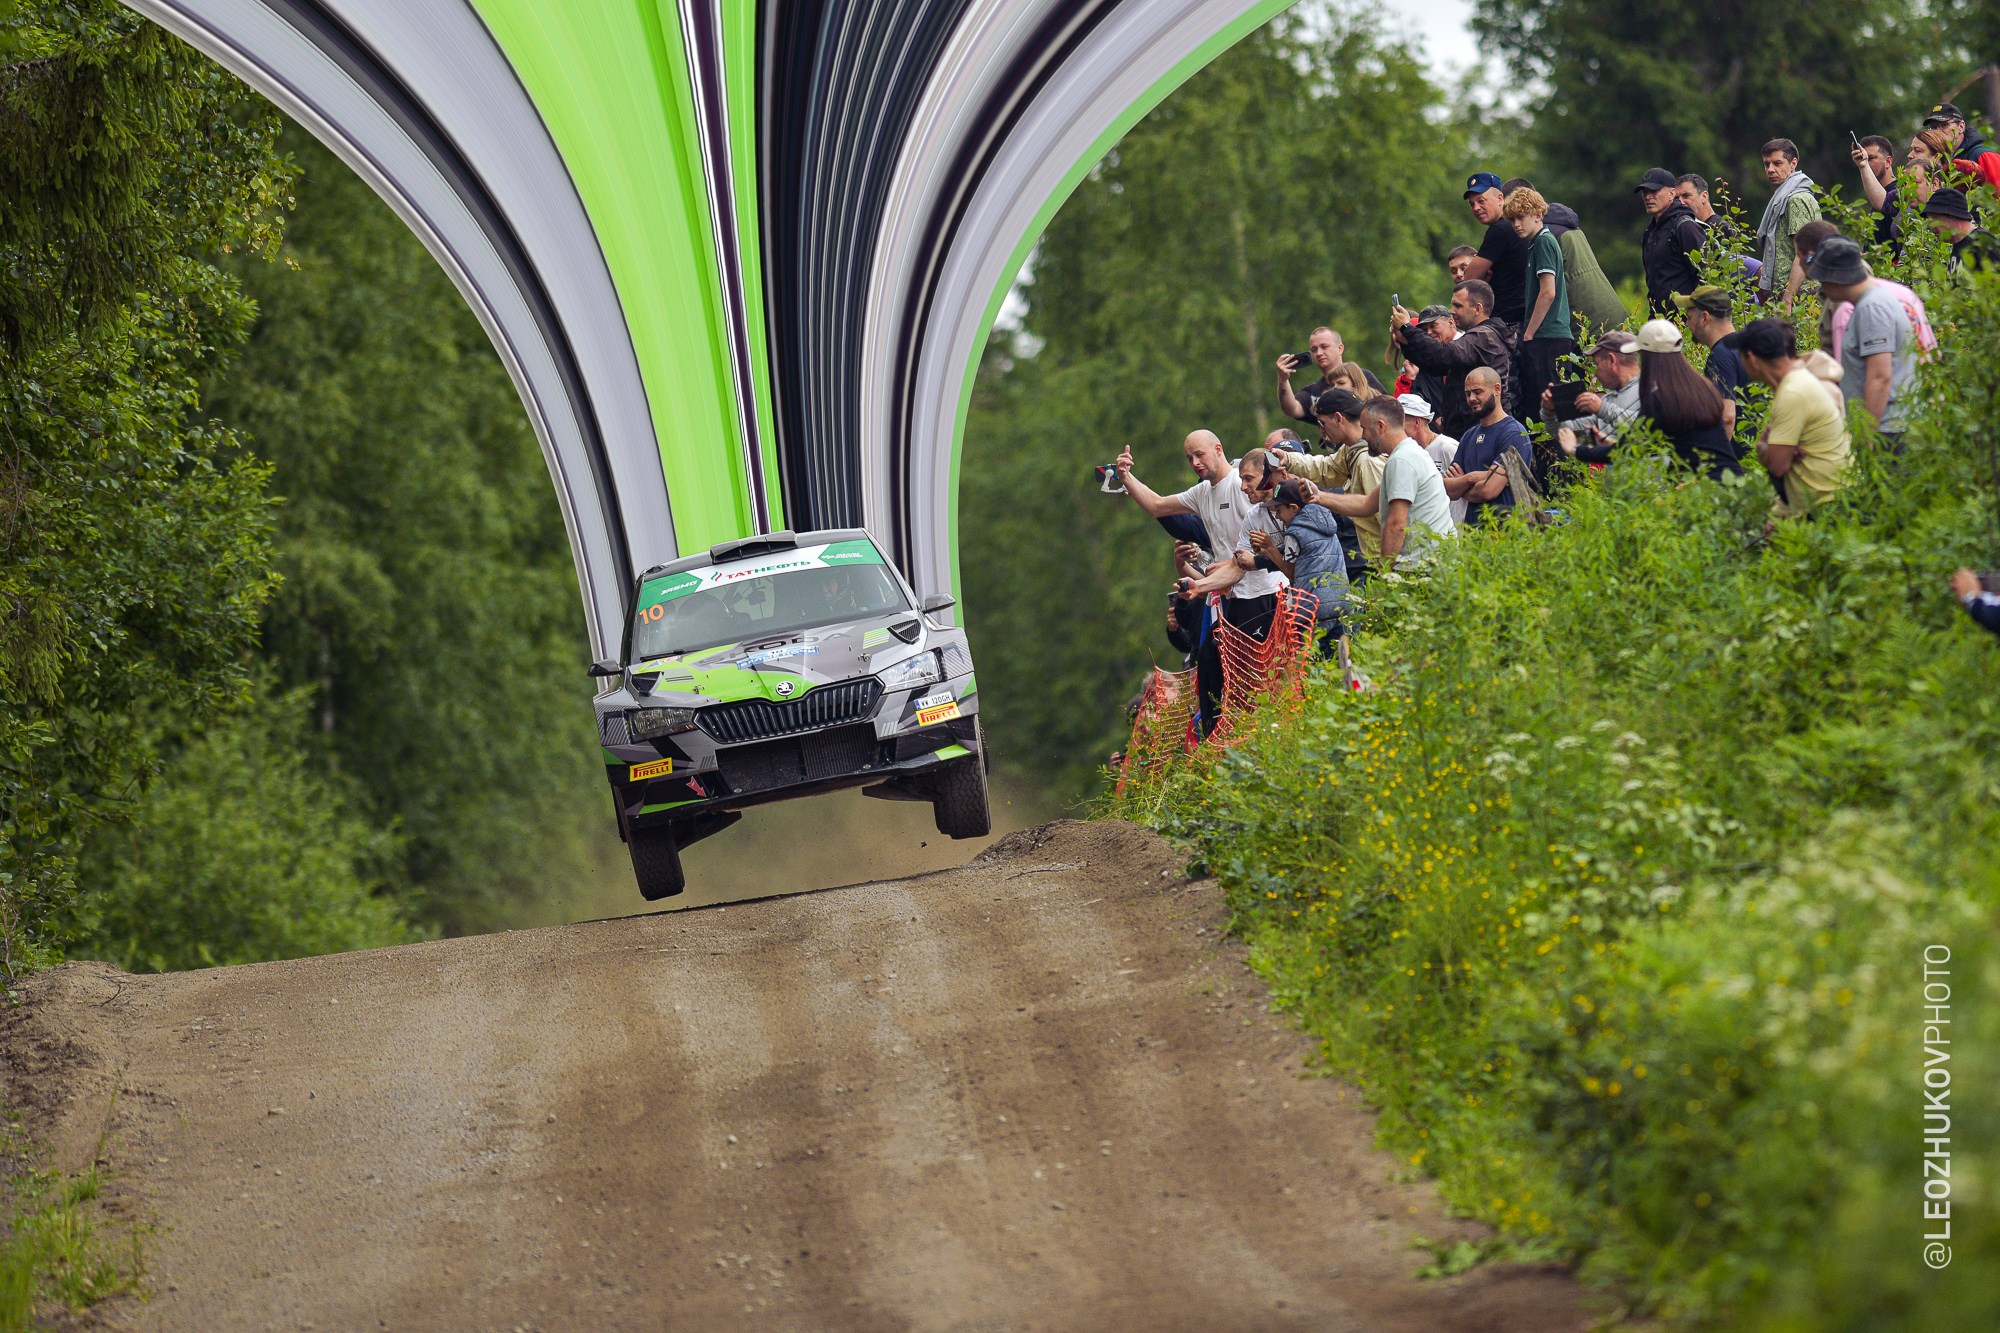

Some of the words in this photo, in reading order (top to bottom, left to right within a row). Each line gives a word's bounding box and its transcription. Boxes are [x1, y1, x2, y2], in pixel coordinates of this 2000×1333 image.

[726, 561, 811, 579] ТАТНЕФТЬ
[639, 604, 665, 625] 10
[919, 705, 956, 723] PIRELLI
[633, 760, 669, 779] PIRELLI
